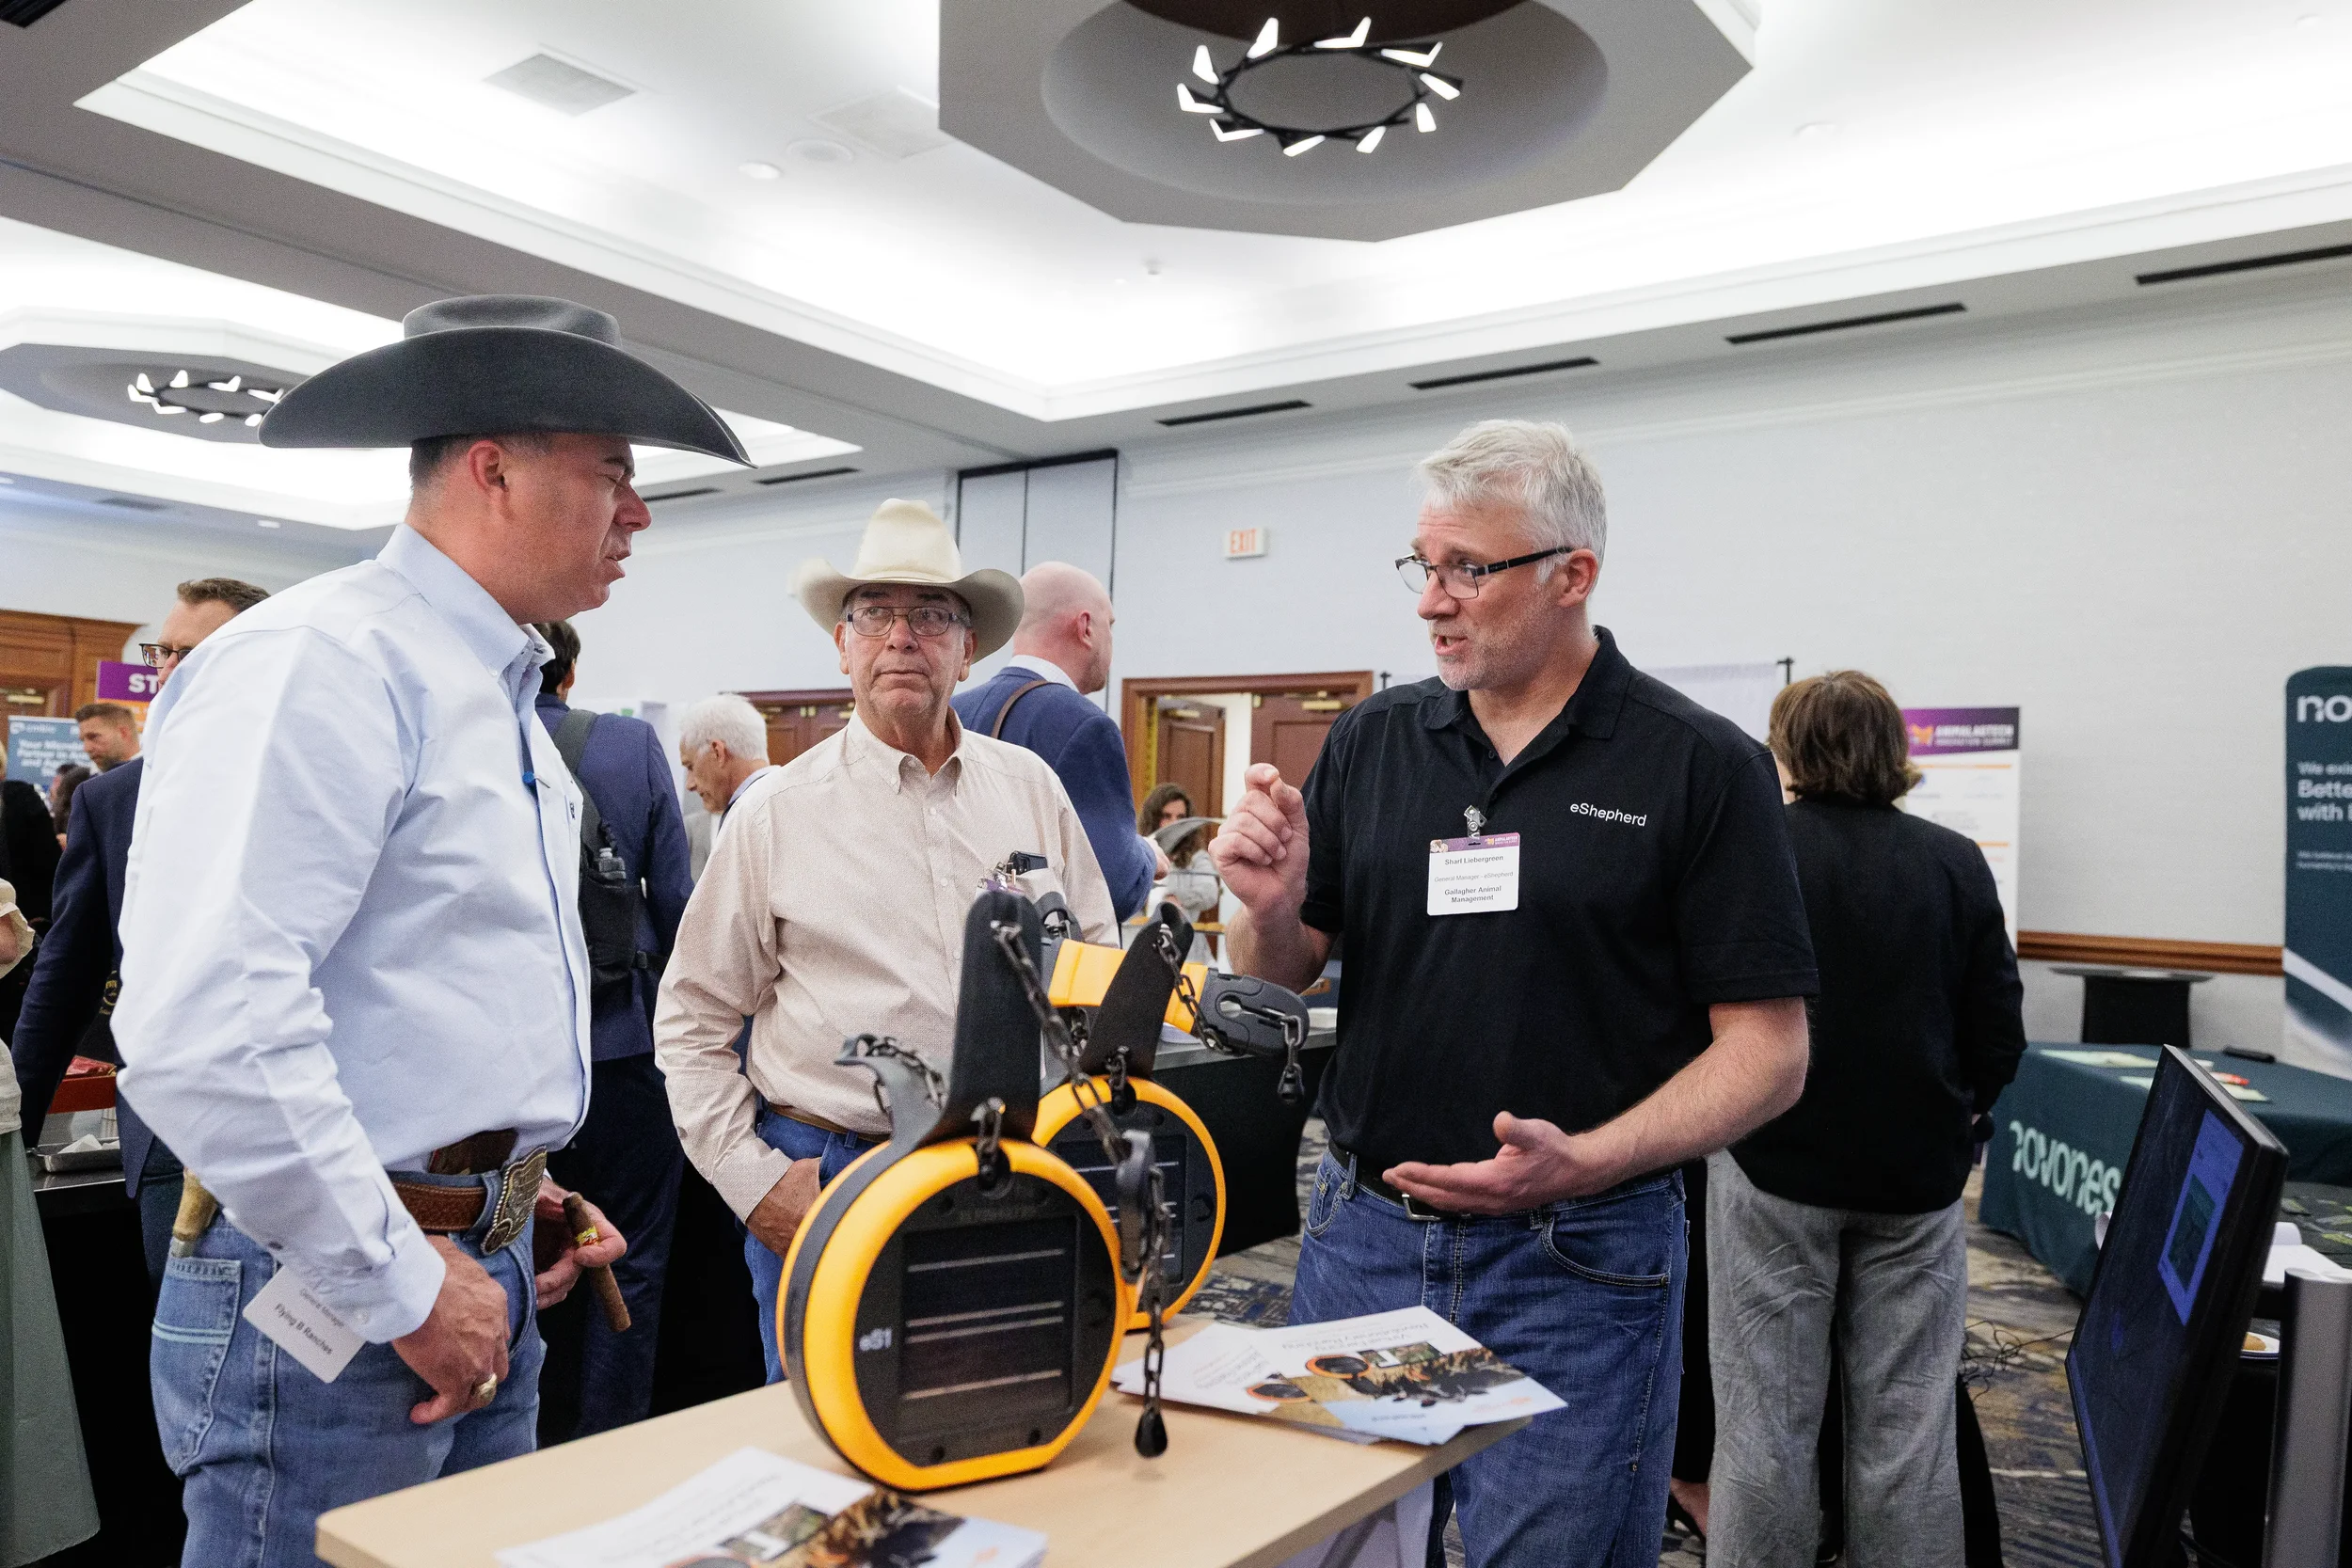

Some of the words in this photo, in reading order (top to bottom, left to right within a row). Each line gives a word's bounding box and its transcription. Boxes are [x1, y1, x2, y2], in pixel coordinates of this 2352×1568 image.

[1570, 802, 1647, 827] eShepherd
[2297, 803, 2344, 821] with
[1464, 855, 1503, 864] Liebergreen
[1456, 874, 1479, 882] Manager
[1484, 871, 1514, 880] eShepherd
[1444, 887, 1477, 896] Gallagher
[1451, 895, 1494, 904] Management
[303, 1326, 332, 1355] Ranches
